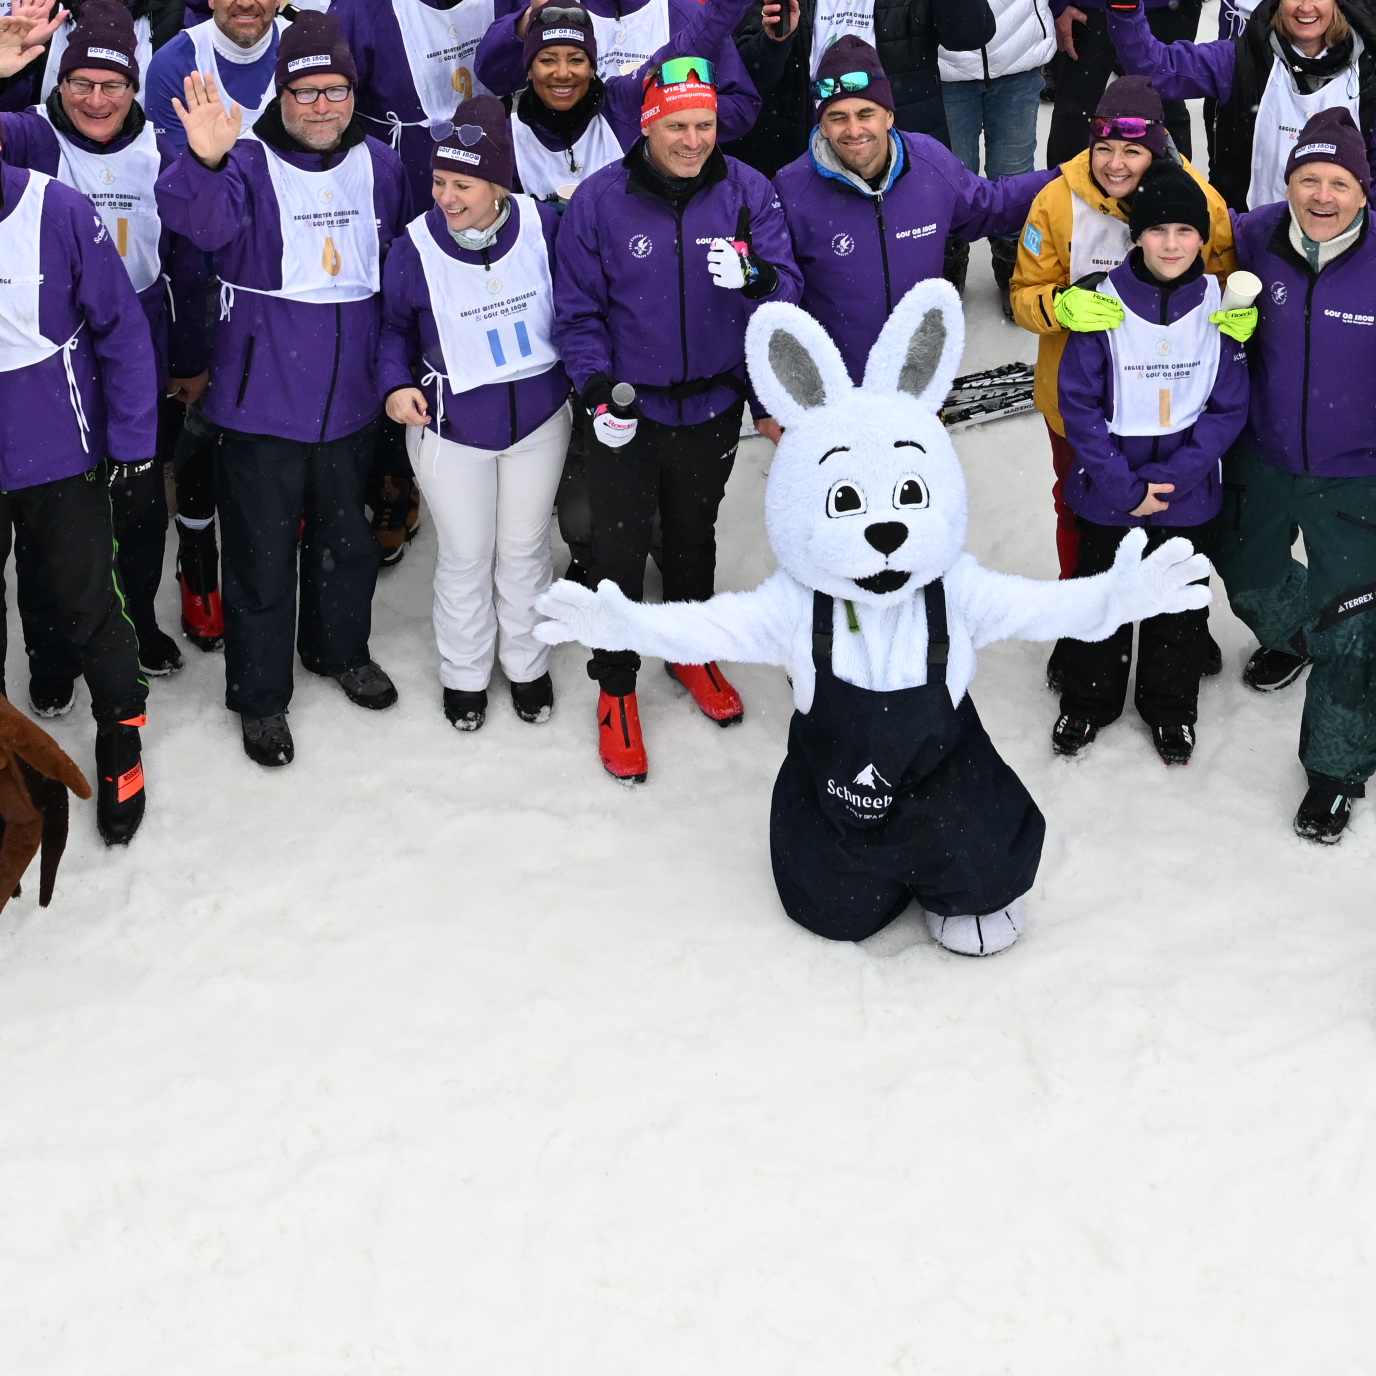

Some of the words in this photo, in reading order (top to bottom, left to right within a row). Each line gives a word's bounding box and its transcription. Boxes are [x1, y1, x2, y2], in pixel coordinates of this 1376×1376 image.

[896, 230, 911, 239] GOLF
[922, 223, 937, 233] SNOW
[1324, 309, 1341, 318] GOLF
[1342, 312, 1353, 320] ON
[1354, 314, 1375, 323] SNOW
[1344, 593, 1374, 610] TERREX
[826, 778, 893, 809] Schneeb
